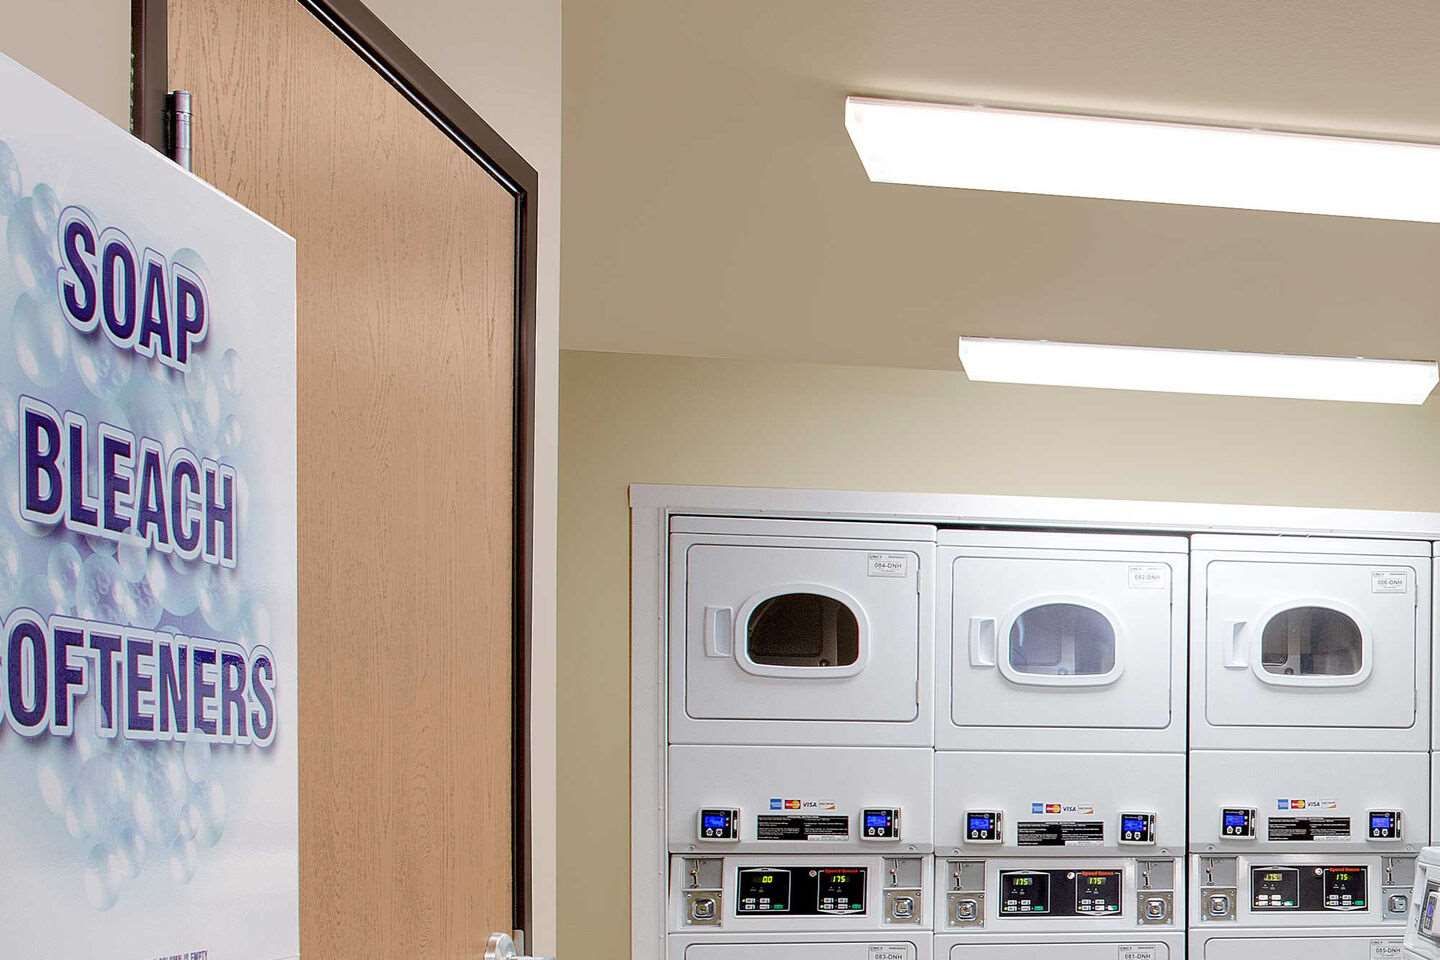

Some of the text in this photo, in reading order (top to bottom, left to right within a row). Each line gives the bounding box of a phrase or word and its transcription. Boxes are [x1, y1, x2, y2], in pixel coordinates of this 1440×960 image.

[61, 216, 207, 367] SOAP
[23, 405, 236, 563] BLEACH
[0, 620, 277, 742] OFTENERS
